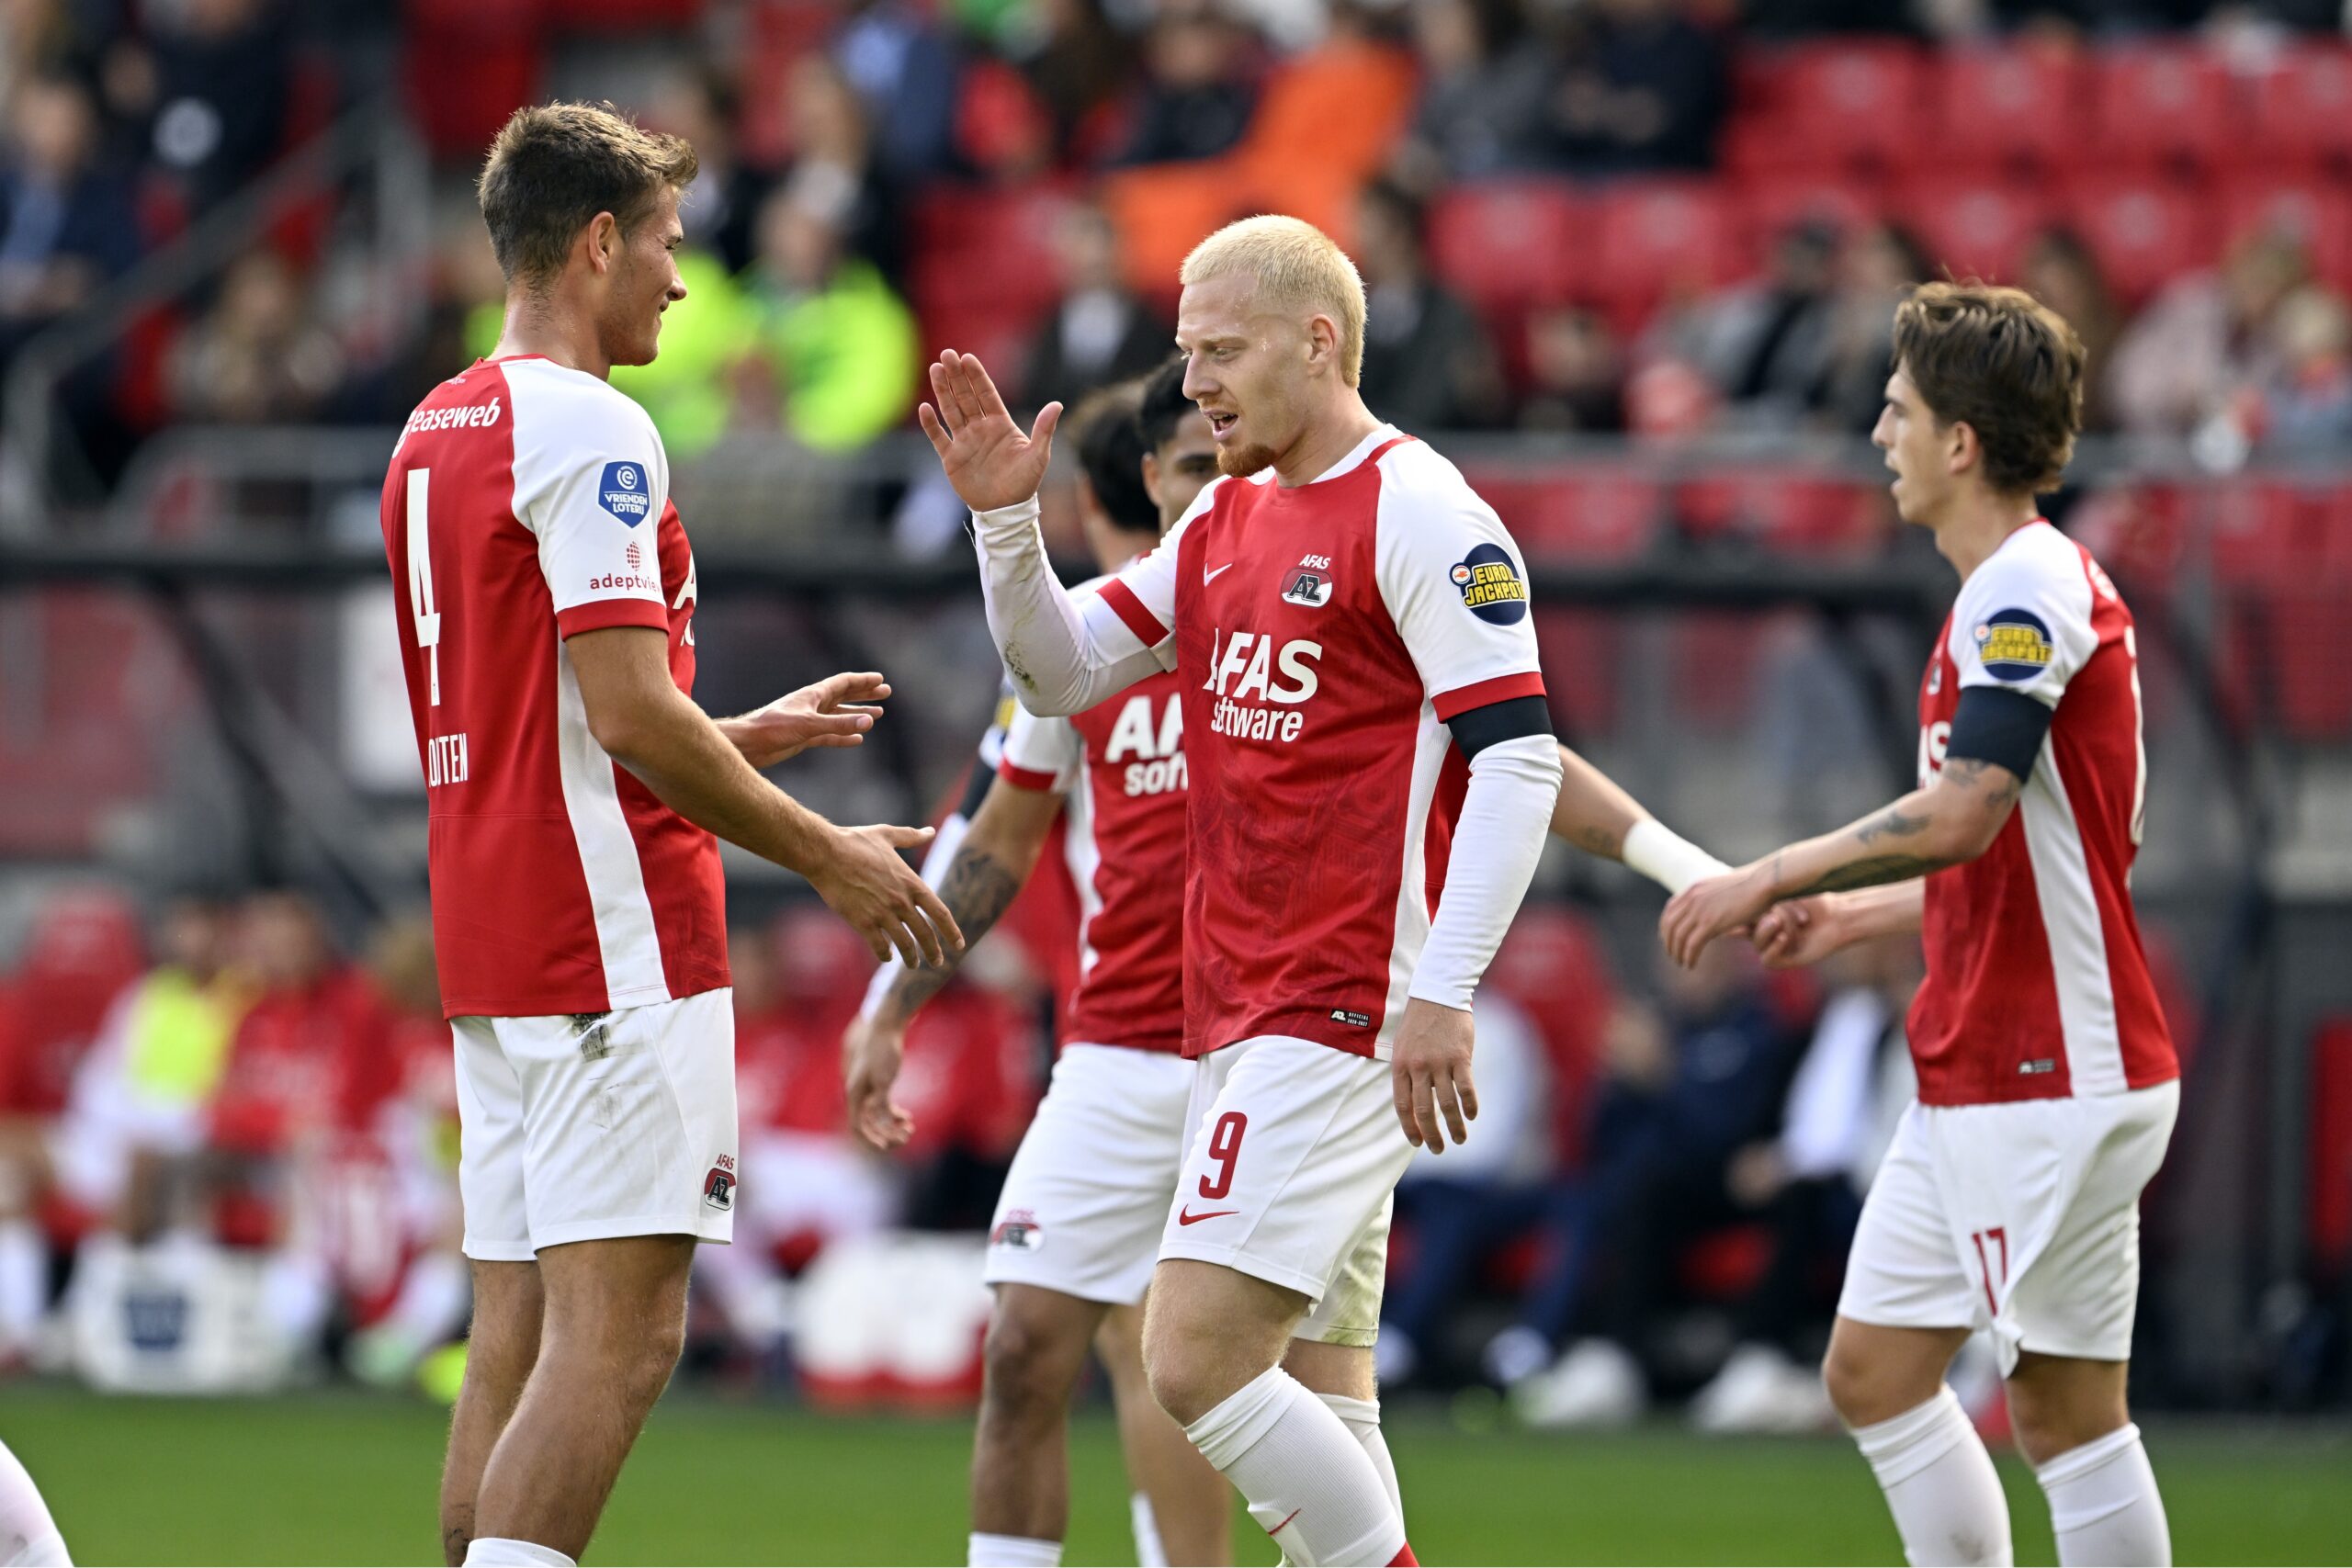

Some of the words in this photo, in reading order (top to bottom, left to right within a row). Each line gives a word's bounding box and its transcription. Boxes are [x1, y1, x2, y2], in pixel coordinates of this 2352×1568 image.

[409, 397, 502, 436] easeweb
[605, 493, 648, 505] VRIENDEN
[613, 502, 644, 514] LOTERIJ
[1298, 554, 1331, 570] AFAS
[1475, 564, 1510, 585] EURO
[407, 468, 441, 706] 4
[590, 573, 660, 591] adeptvie
[1287, 573, 1321, 603] AZ
[1465, 581, 1525, 606] JACKPOT
[716, 1153, 735, 1170] AFAS
[1198, 1111, 1248, 1200] 9
[707, 1176, 729, 1206] AZ
[1972, 1226, 2007, 1317] 17
